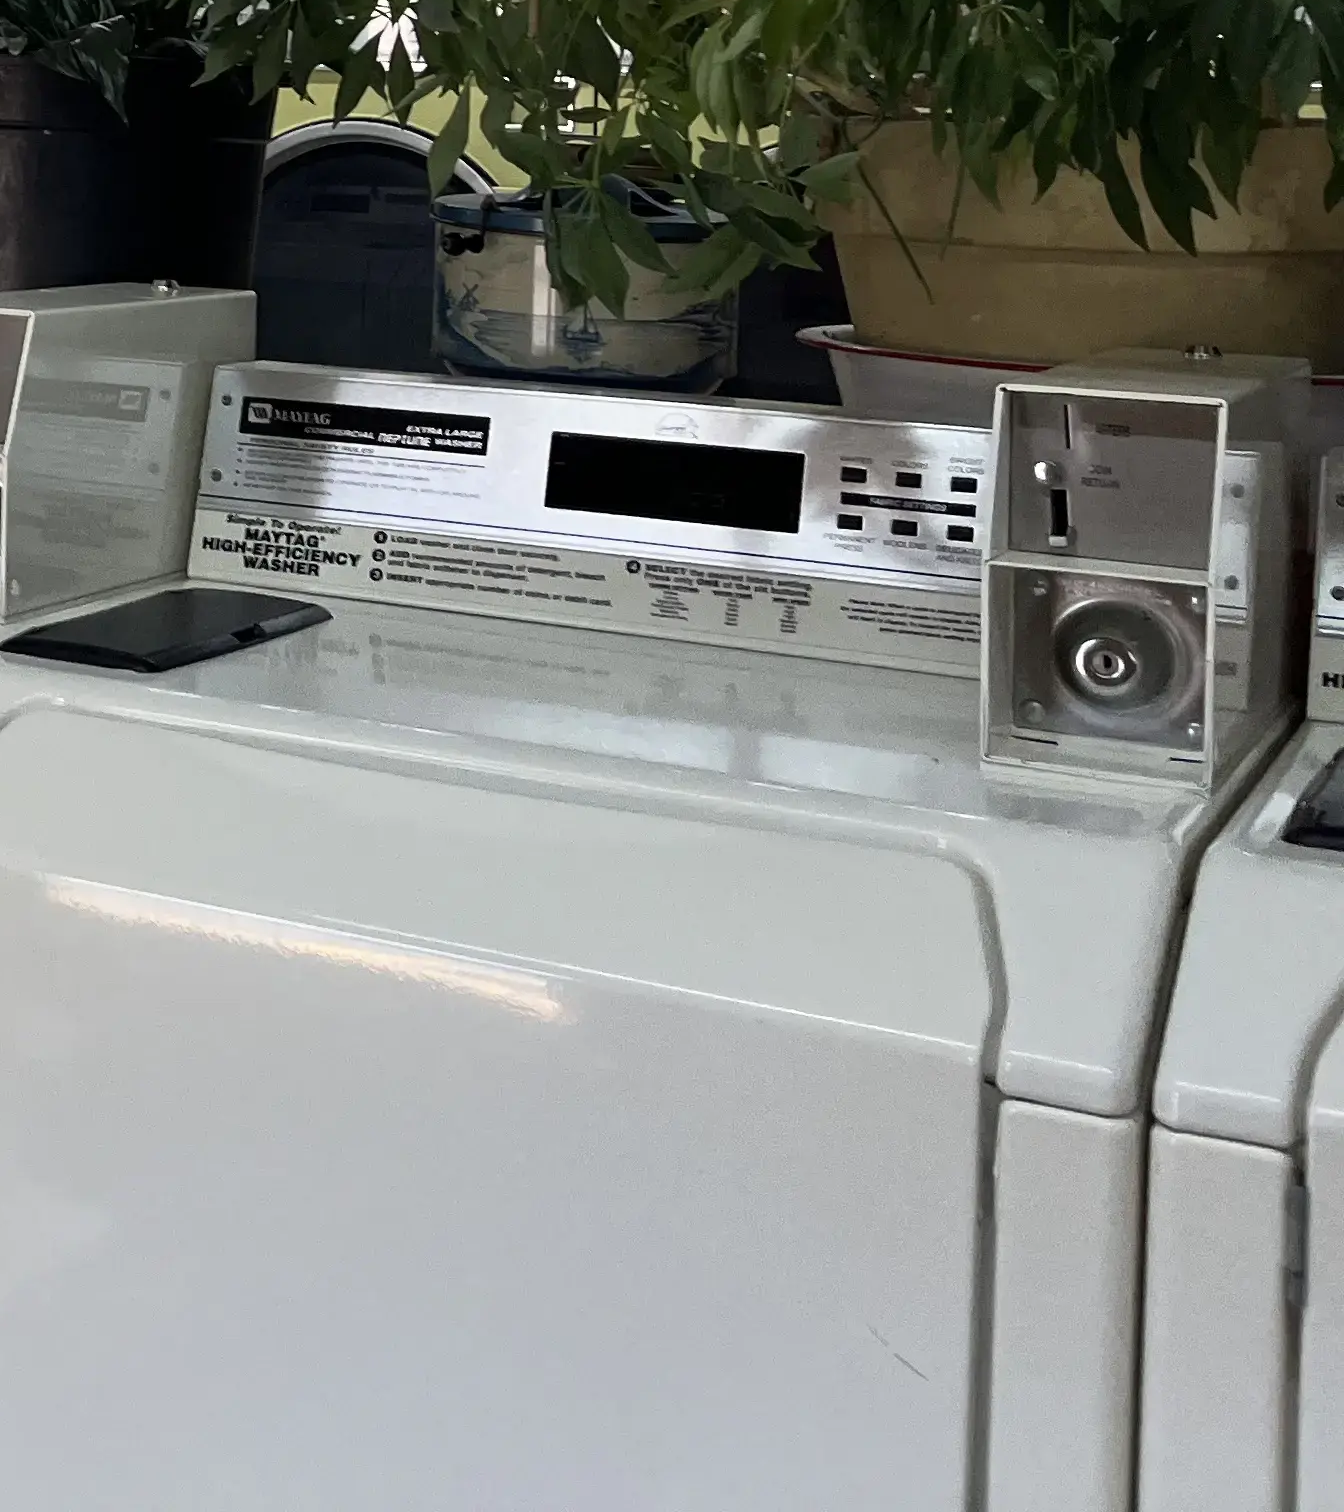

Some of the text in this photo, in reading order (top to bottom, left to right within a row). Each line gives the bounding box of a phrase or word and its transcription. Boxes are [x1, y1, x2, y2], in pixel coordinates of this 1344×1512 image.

[273, 407, 332, 426] MAYTAG
[243, 527, 320, 548] MAYTAG
[202, 536, 362, 567] HIGH-EFFICIENCY
[242, 555, 320, 577] WASHER
